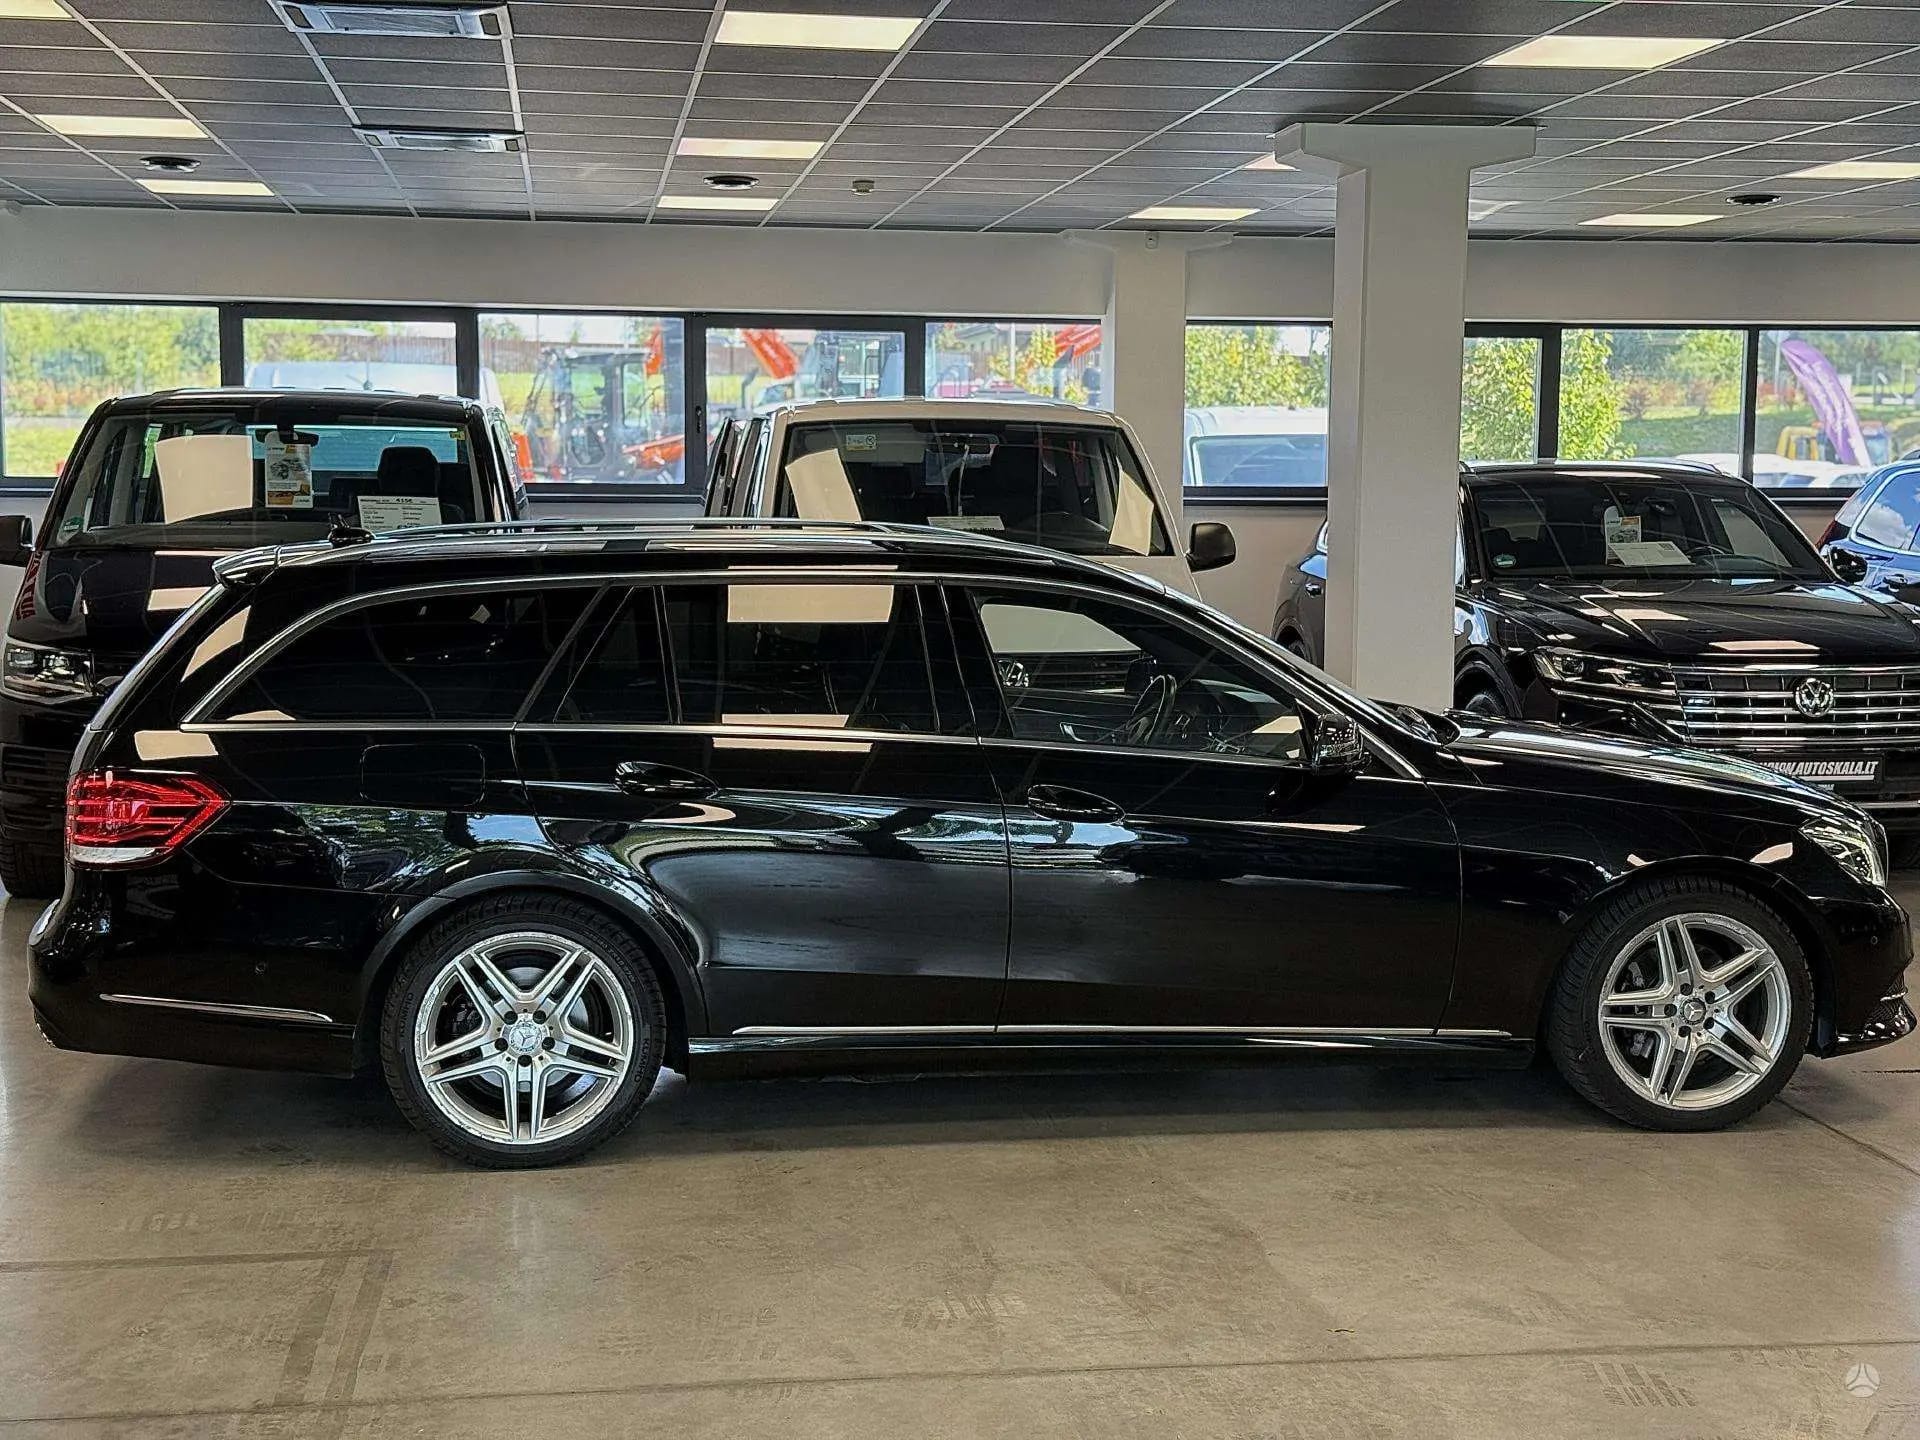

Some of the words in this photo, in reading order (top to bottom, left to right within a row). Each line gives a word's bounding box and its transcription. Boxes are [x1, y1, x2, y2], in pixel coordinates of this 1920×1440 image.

[1759, 761, 1879, 776] W.AUTOSKALA.LT
[400, 992, 416, 1040] KUMHO
[634, 1038, 650, 1083] KUMHO
